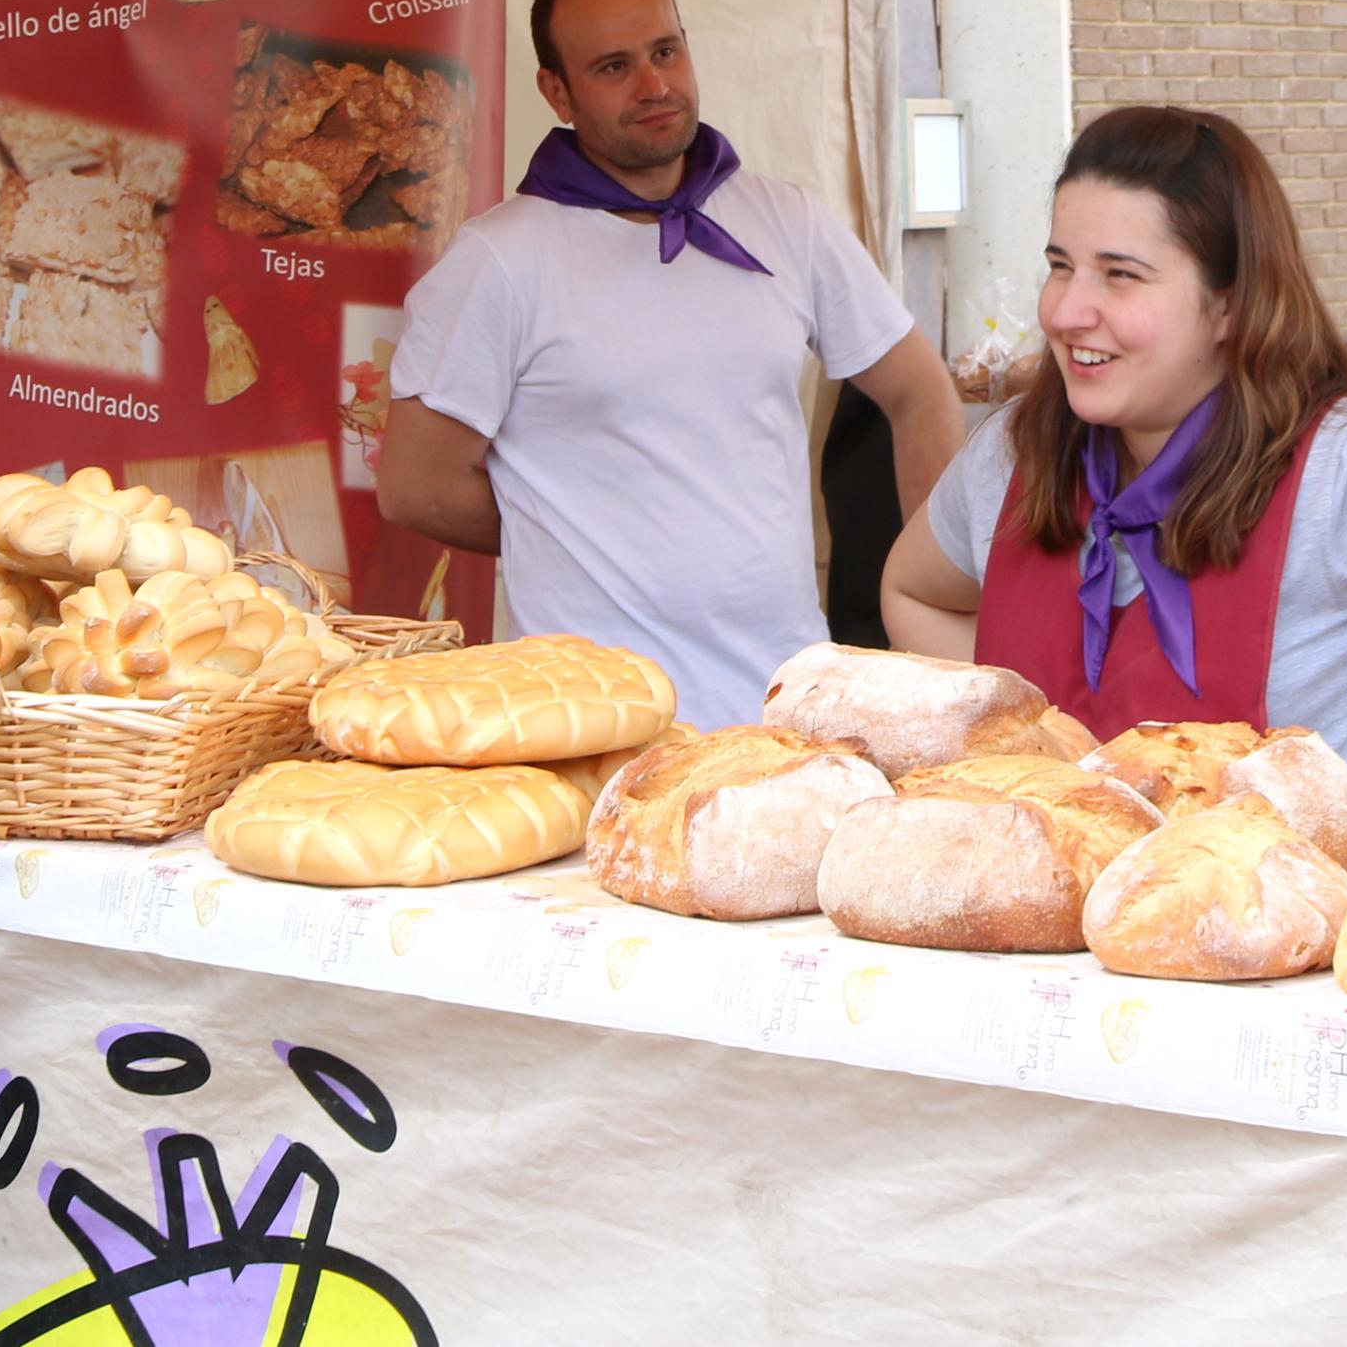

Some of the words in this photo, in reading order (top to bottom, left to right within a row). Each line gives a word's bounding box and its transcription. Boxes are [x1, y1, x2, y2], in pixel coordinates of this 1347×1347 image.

[47, 6, 81, 34] de
[259, 247, 326, 281] Tejas
[9, 373, 161, 424] Almendrados
